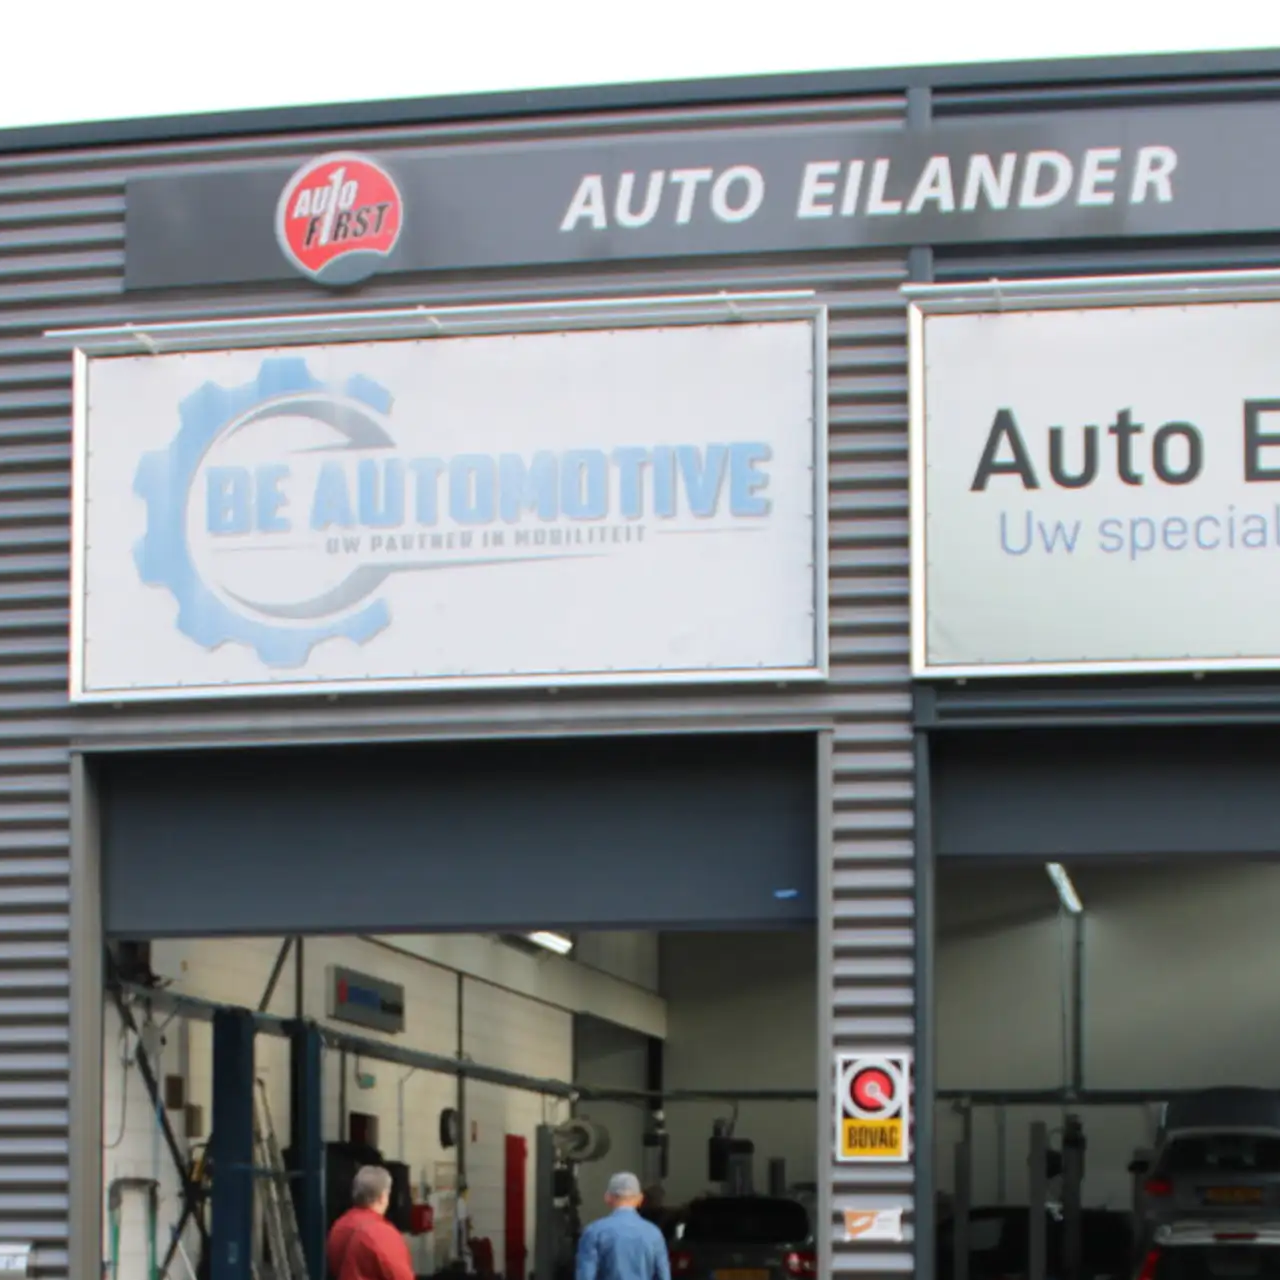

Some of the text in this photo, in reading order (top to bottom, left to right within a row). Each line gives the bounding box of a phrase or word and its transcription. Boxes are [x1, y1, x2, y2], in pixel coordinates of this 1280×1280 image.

[560, 145, 1178, 232] AUTO EILANDER
[205, 441, 774, 536] BE AUTOMOTIVE
[970, 407, 1203, 492] Auto
[998, 509, 1081, 556] Uw
